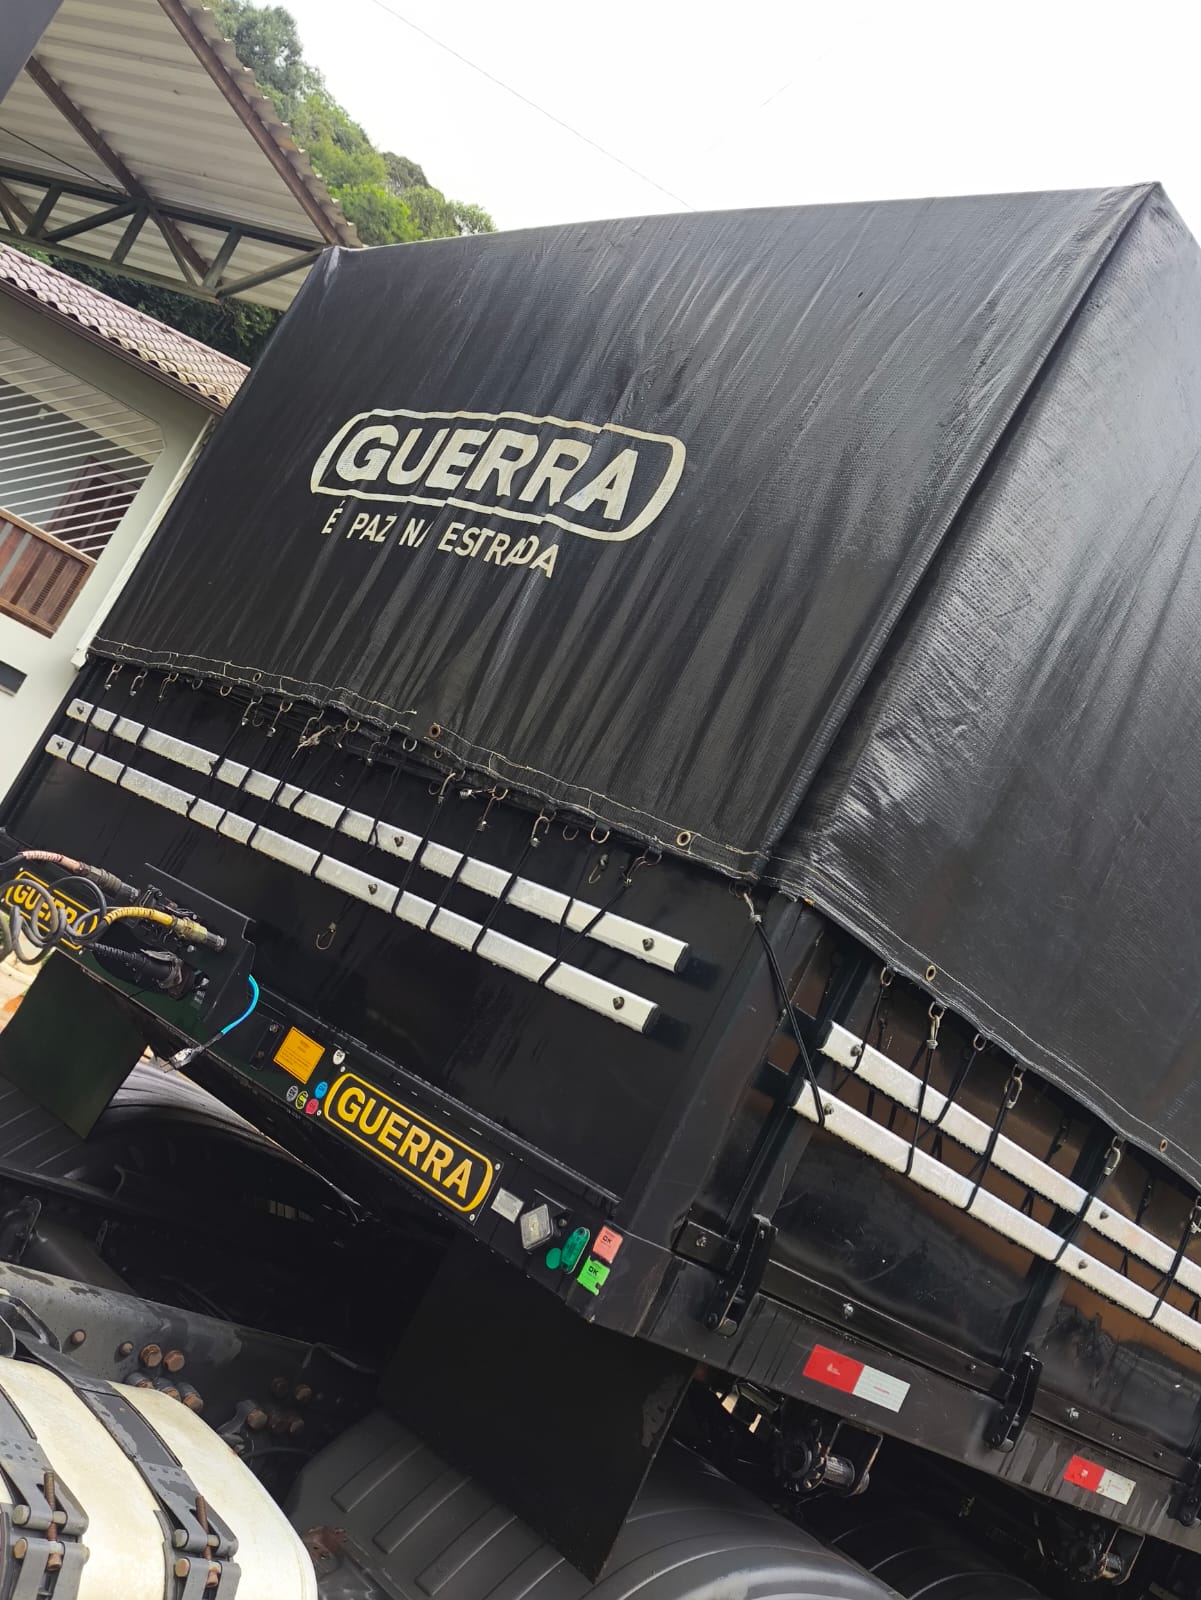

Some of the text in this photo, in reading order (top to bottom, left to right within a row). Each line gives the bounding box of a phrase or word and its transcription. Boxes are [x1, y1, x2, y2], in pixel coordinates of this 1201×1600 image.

[335, 424, 639, 521] GUERRA
[321, 500, 346, 534] É
[346, 512, 398, 542] PAZ
[437, 522, 559, 578] ESTRADA
[336, 1086, 473, 1199] GUERRA
[588, 1265, 599, 1276] OK
